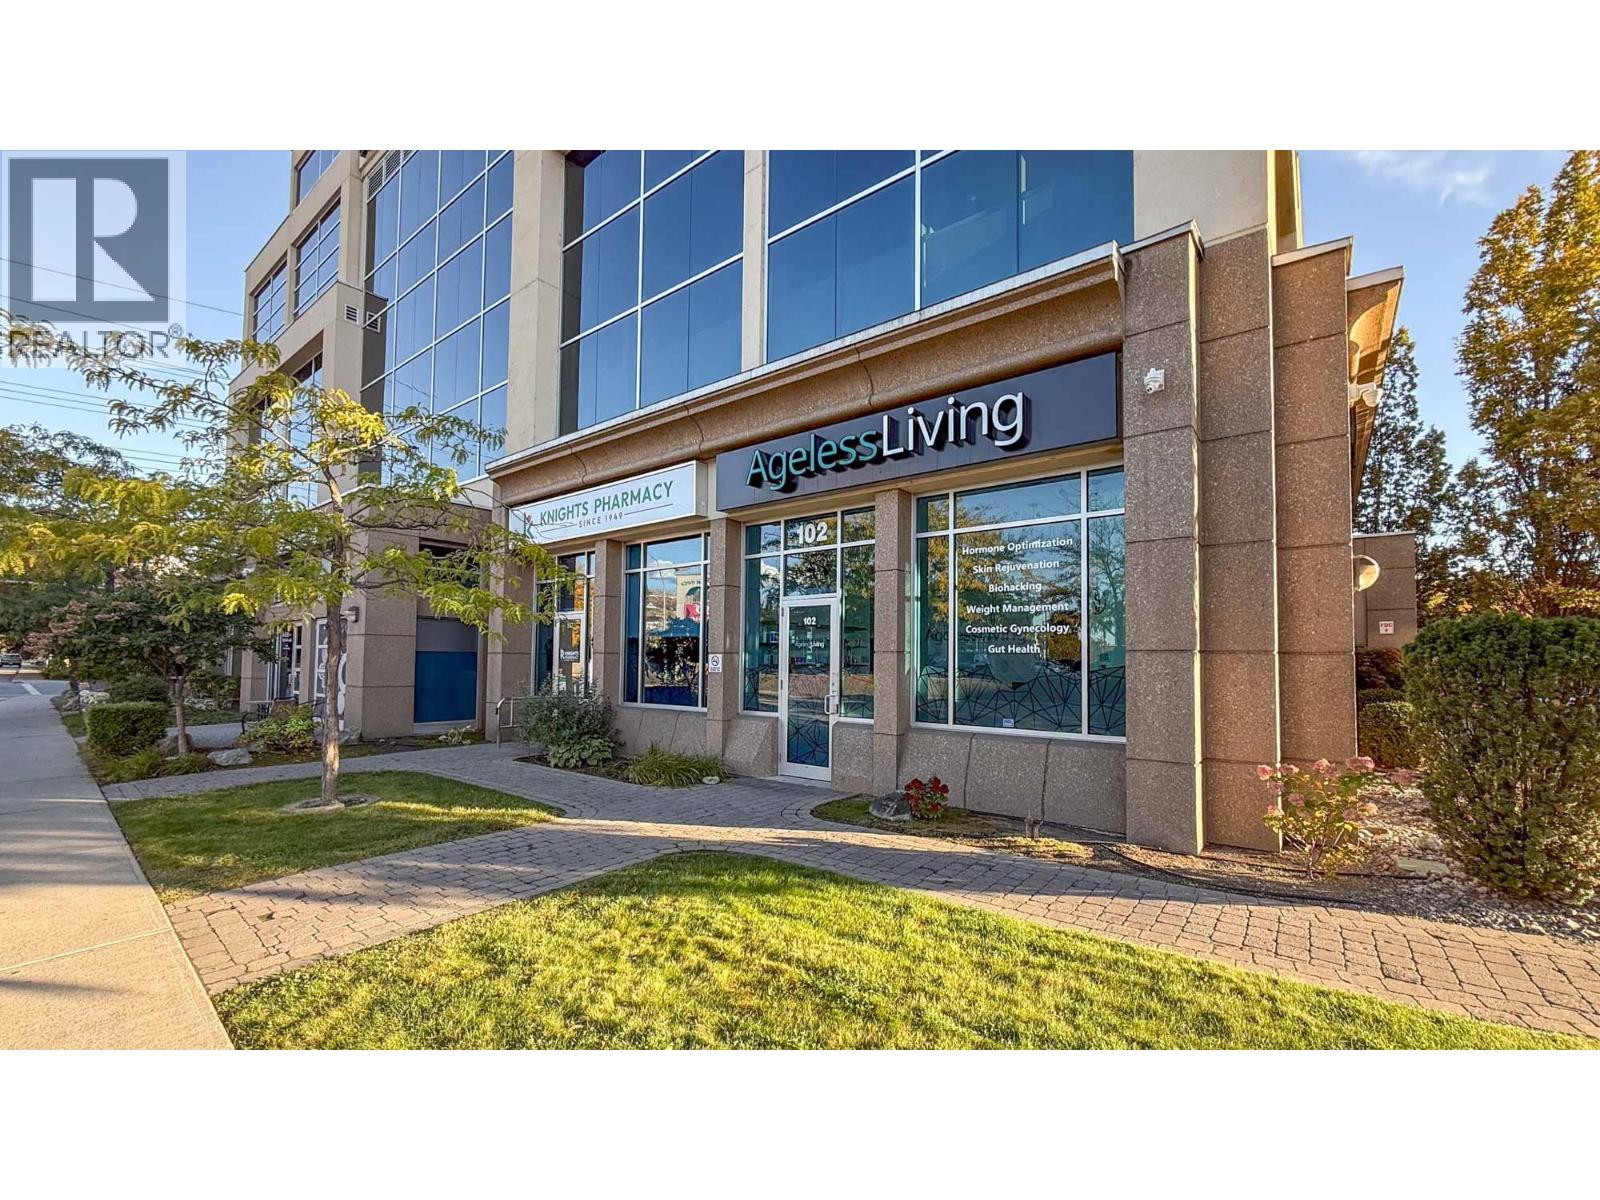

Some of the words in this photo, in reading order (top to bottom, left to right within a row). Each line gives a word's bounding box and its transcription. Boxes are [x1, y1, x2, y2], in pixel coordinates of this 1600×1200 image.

[746, 391, 1024, 491] AgelessLiving
[540, 501, 589, 527] KNIGHTS
[594, 480, 674, 514] PHARMACY
[578, 516, 601, 528] SINCE
[604, 512, 623, 524] 1949
[797, 521, 828, 544] 102
[962, 543, 1006, 555] Hormone
[1007, 538, 1073, 553] Optimization
[973, 565, 993, 574] Skin
[995, 560, 1060, 574] Rejuvenation
[988, 582, 1042, 594] Biohacking
[966, 604, 1000, 616] Weight
[1002, 602, 1069, 615] Management
[803, 616, 817, 626] 102
[965, 624, 1008, 634] Cosmetic
[1009, 624, 1070, 636] Gynecology
[987, 644, 1006, 654] Gut
[1007, 644, 1041, 654] Health
